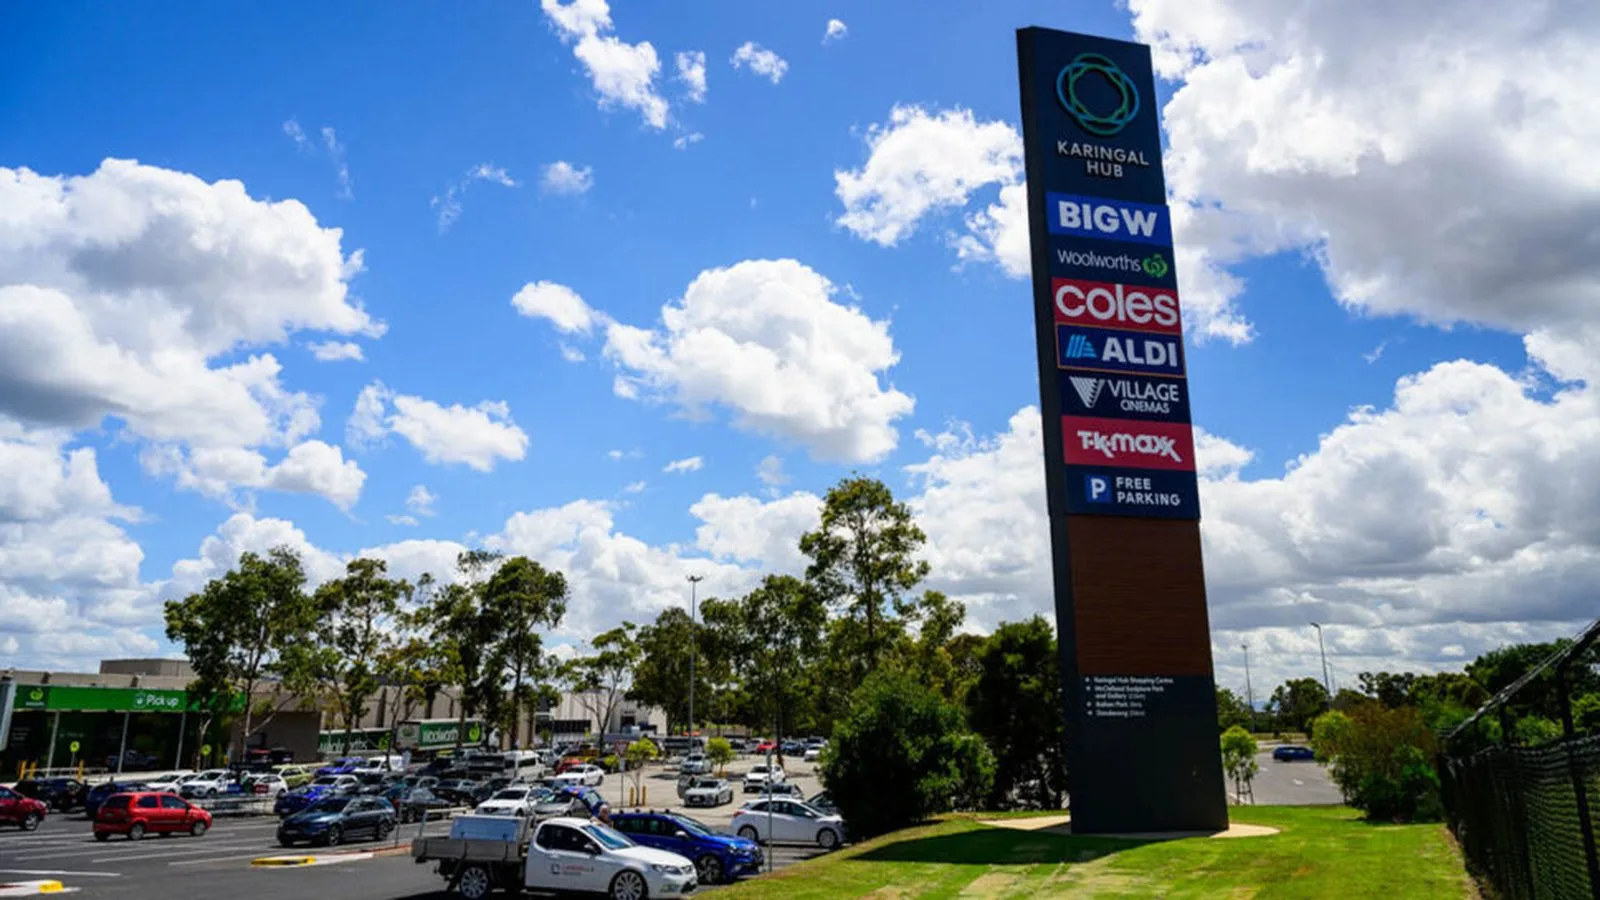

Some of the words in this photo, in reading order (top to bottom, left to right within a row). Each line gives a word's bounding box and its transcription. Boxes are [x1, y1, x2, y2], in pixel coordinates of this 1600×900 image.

[1057, 140, 1150, 166] KARINGAL
[1086, 160, 1124, 178] HUB
[1057, 249, 1142, 273] Woolworths
[1055, 284, 1178, 326] coles
[1101, 337, 1178, 367] ALDI
[1107, 379, 1180, 402] VILLAGE
[1120, 399, 1170, 414] CINEMAS
[1090, 478, 1107, 500] P
[1115, 476, 1152, 491] FREE
[1116, 491, 1181, 507] PARKING
[145, 693, 165, 706] Pick
[166, 696, 179, 708] up
